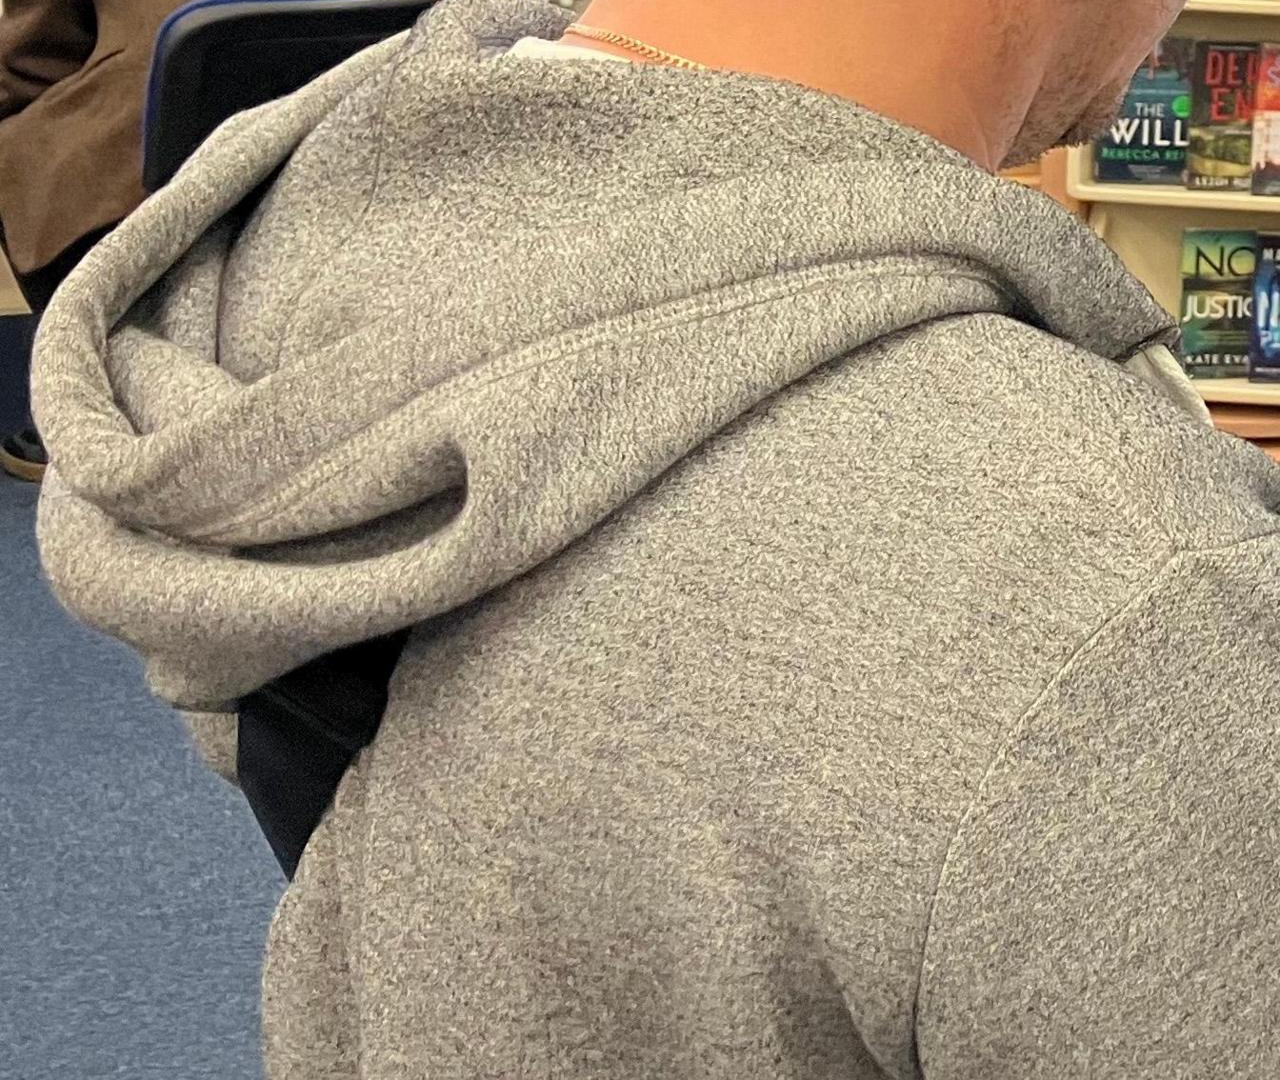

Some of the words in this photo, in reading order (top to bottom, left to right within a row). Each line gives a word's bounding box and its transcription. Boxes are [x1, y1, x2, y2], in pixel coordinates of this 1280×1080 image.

[1134, 103, 1165, 117] THE
[1210, 88, 1250, 120] EN
[1110, 118, 1190, 146] WILL
[1102, 147, 1160, 160] REBECCA
[1183, 295, 1253, 322] JUSTIC
[1223, 353, 1249, 364] EVA
